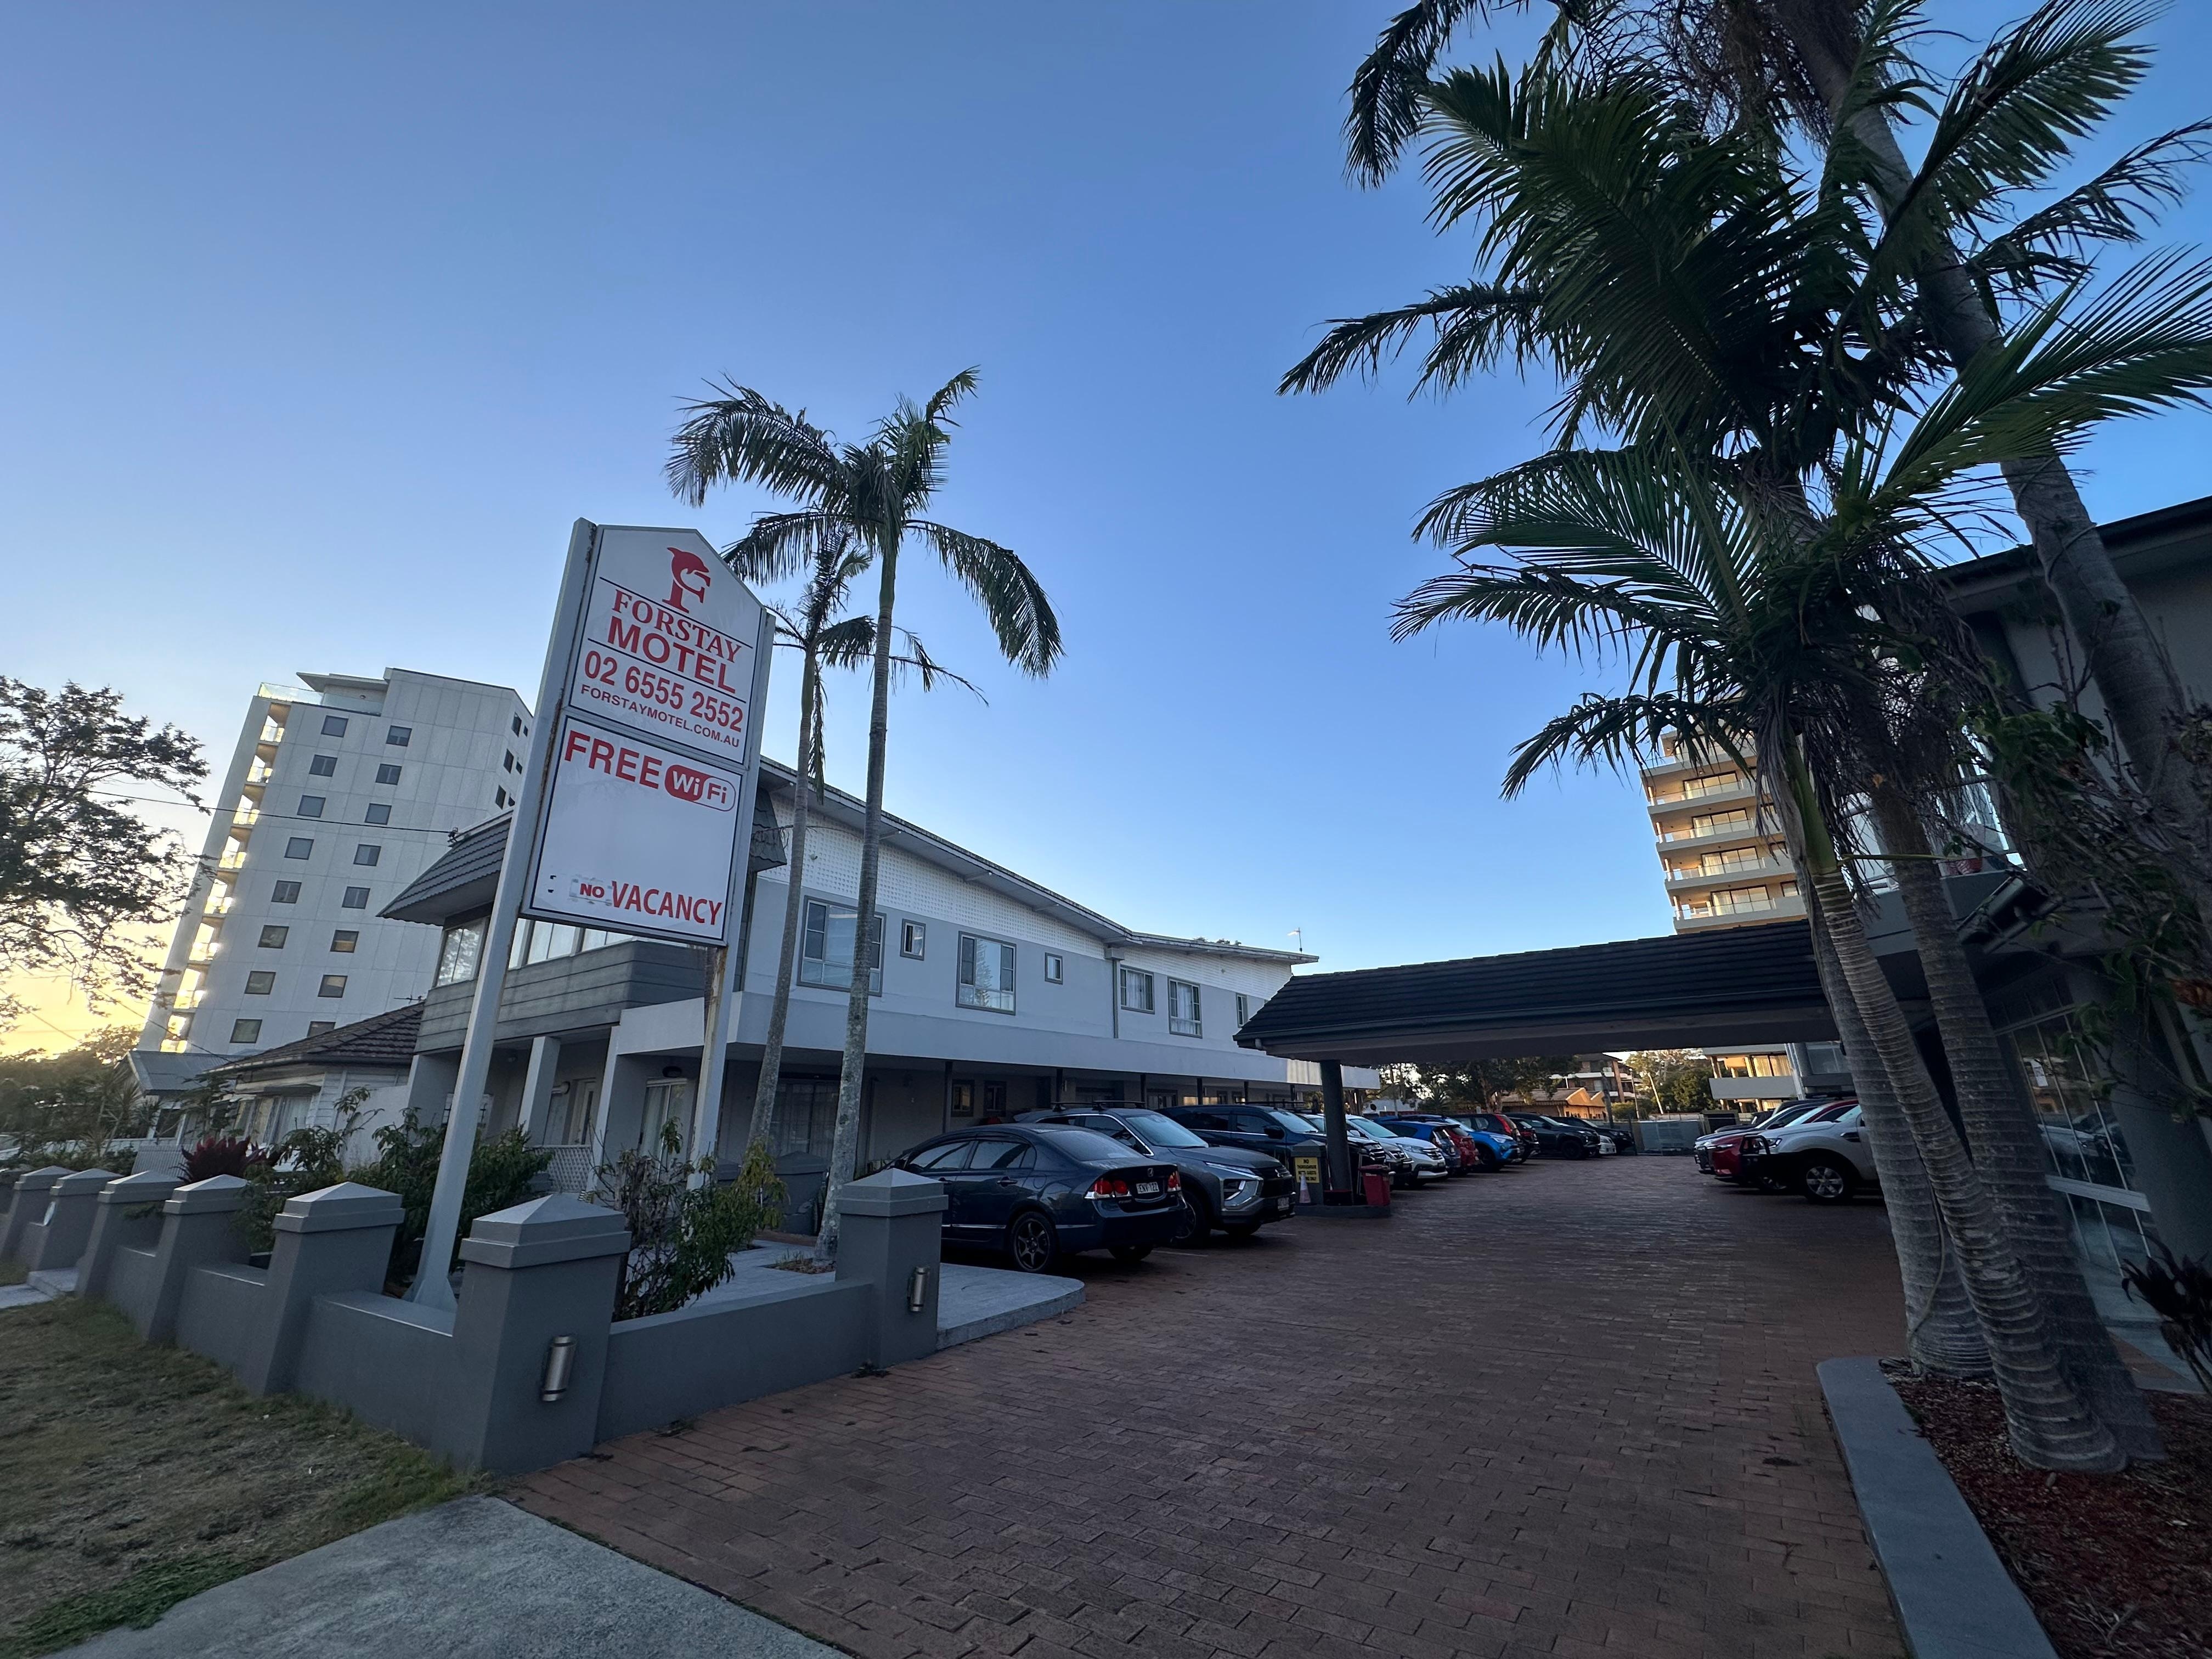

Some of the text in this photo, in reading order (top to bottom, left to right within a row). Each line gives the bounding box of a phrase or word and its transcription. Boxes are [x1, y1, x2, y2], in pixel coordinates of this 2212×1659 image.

[607, 616, 736, 694] MOTEL
[612, 589, 743, 663] FORSTAY
[580, 684, 740, 748] FORSTAYMOTEL.COM.AU
[584, 650, 743, 732] 02 6555 2552
[564, 730, 663, 789] FREE
[579, 881, 723, 926] NO VACANCY
